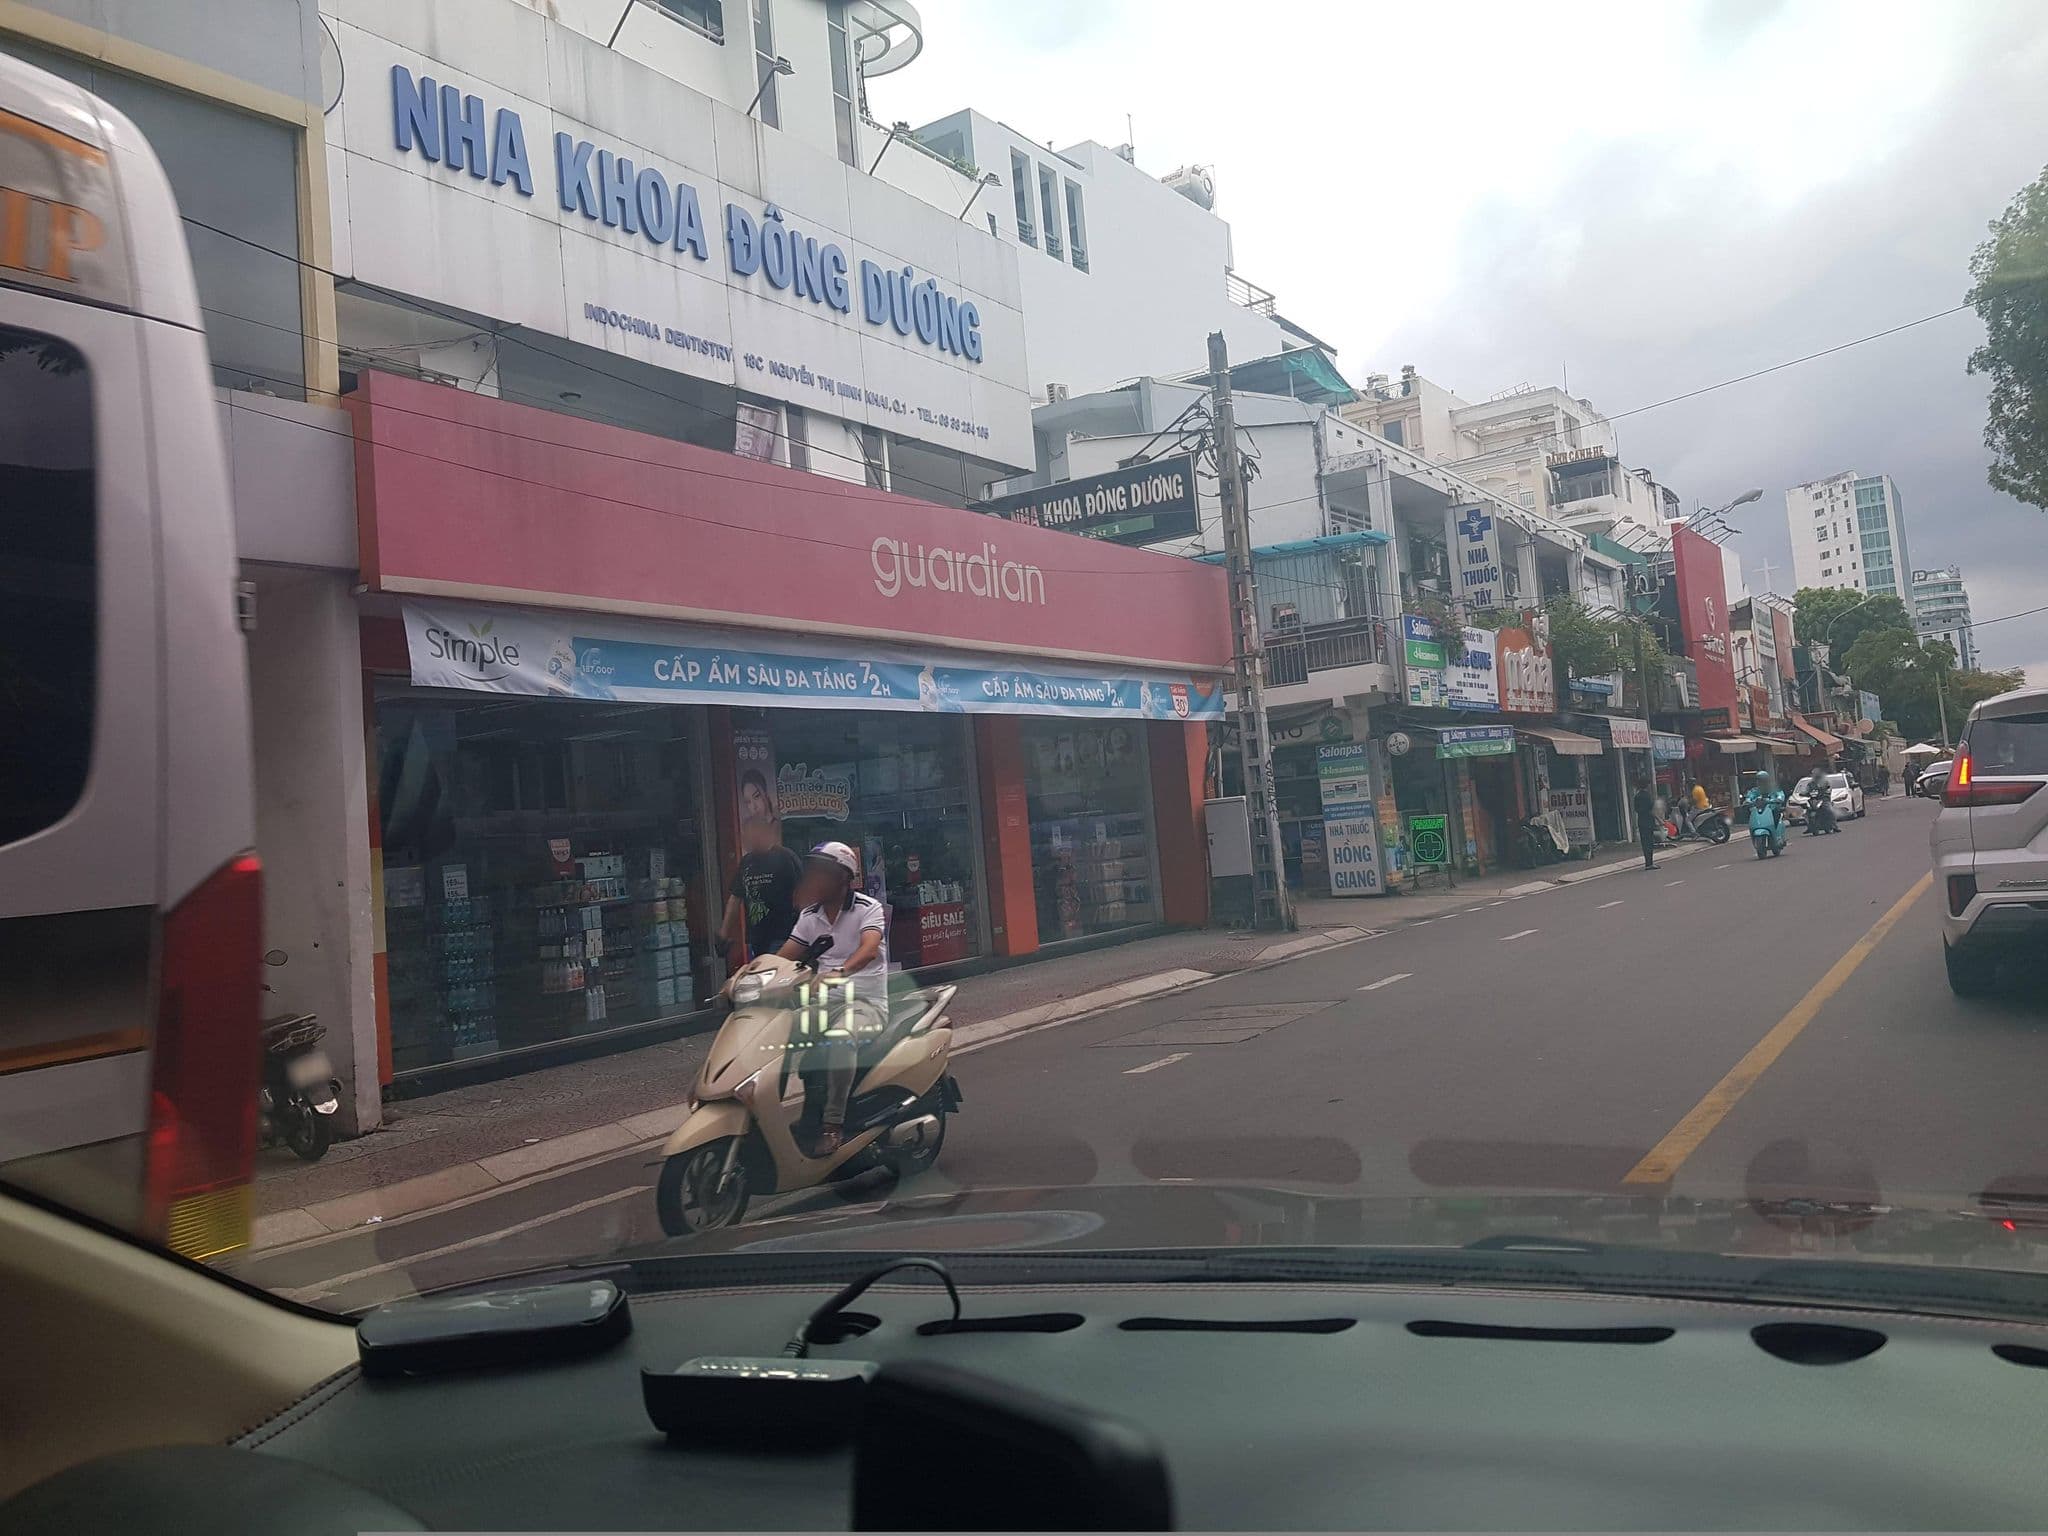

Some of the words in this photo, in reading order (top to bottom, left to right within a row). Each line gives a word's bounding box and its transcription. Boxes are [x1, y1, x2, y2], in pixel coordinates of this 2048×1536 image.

[392, 64, 534, 196] NHA
[556, 132, 708, 260] KHOA
[726, 202, 851, 314] ĐÔNG
[860, 258, 983, 363] DƯƠNG
[584, 302, 660, 340] INDOCHINA
[665, 327, 733, 362] DENTISTRY
[817, 375, 835, 396] THỊ
[837, 381, 862, 402] MINH
[1042, 495, 1082, 527] KHOA
[1085, 484, 1127, 517] ĐÔNG
[1130, 473, 1184, 508] DƯƠNG
[1467, 544, 1489, 565] NHÀ
[870, 535, 1046, 605] guardian
[1462, 563, 1498, 586] THUỐC
[1473, 587, 1492, 606] TÂY
[425, 627, 520, 672] Simple
[654, 654, 700, 682] CẤP
[708, 656, 740, 684] ẨM
[747, 664, 780, 687] SÂU
[785, 670, 810, 688] ĐA
[812, 666, 857, 690] TẦNG
[982, 676, 1009, 697] CẤP
[1060, 687, 1076, 700] ĐA
[1320, 744, 1363, 758] Salonpas
[1329, 822, 1344, 837] NHÀ
[1345, 820, 1370, 835] THUỐC
[1333, 838, 1372, 864] HỒNG
[1335, 869, 1377, 889] GIANG
[921, 911, 941, 929] SIÊU
[943, 910, 965, 926] SALE
[800, 977, 855, 1037] 10
